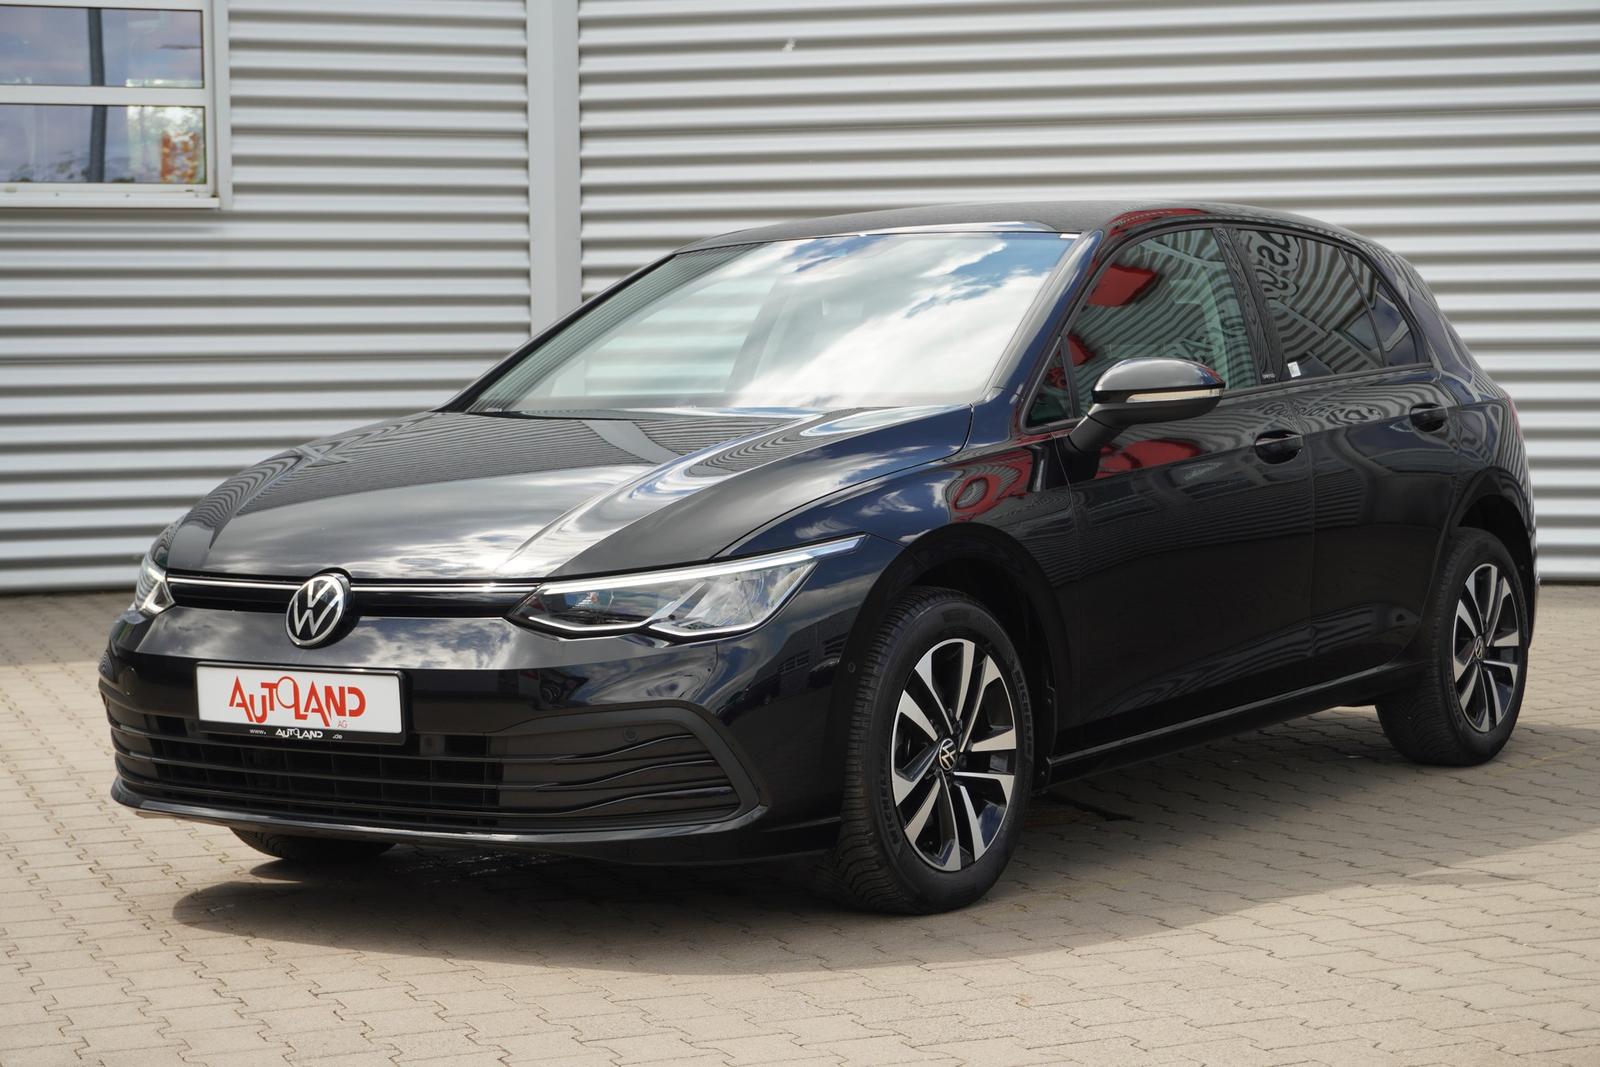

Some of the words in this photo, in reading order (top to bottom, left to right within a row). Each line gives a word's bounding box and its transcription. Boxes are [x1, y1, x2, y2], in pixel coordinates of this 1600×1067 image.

[229, 675, 366, 727] AUTOLAND
[337, 719, 348, 729] AG
[275, 728, 323, 740] AUTOLAND
